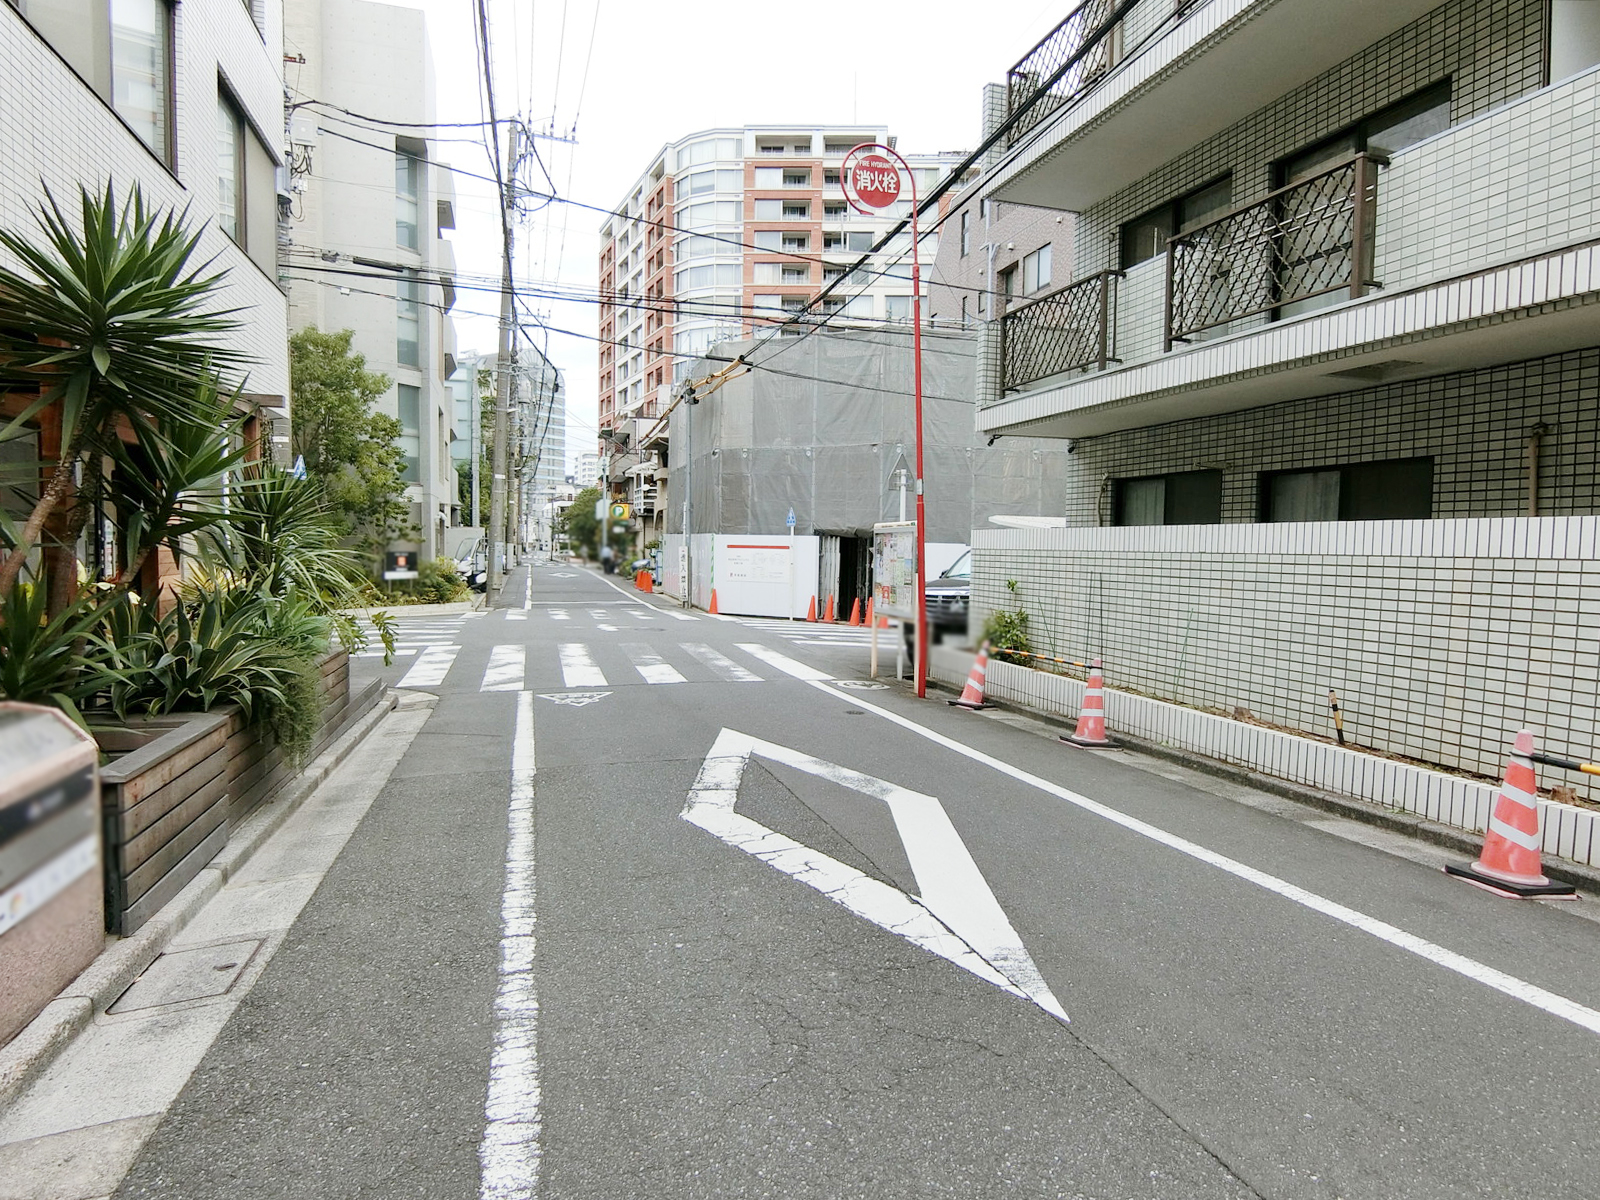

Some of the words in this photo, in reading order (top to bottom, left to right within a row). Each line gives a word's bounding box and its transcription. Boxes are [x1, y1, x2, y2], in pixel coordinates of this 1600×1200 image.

[871, 161, 892, 169] HYDRANT
[855, 169, 897, 193] 消火栓
[616, 506, 624, 516] P
